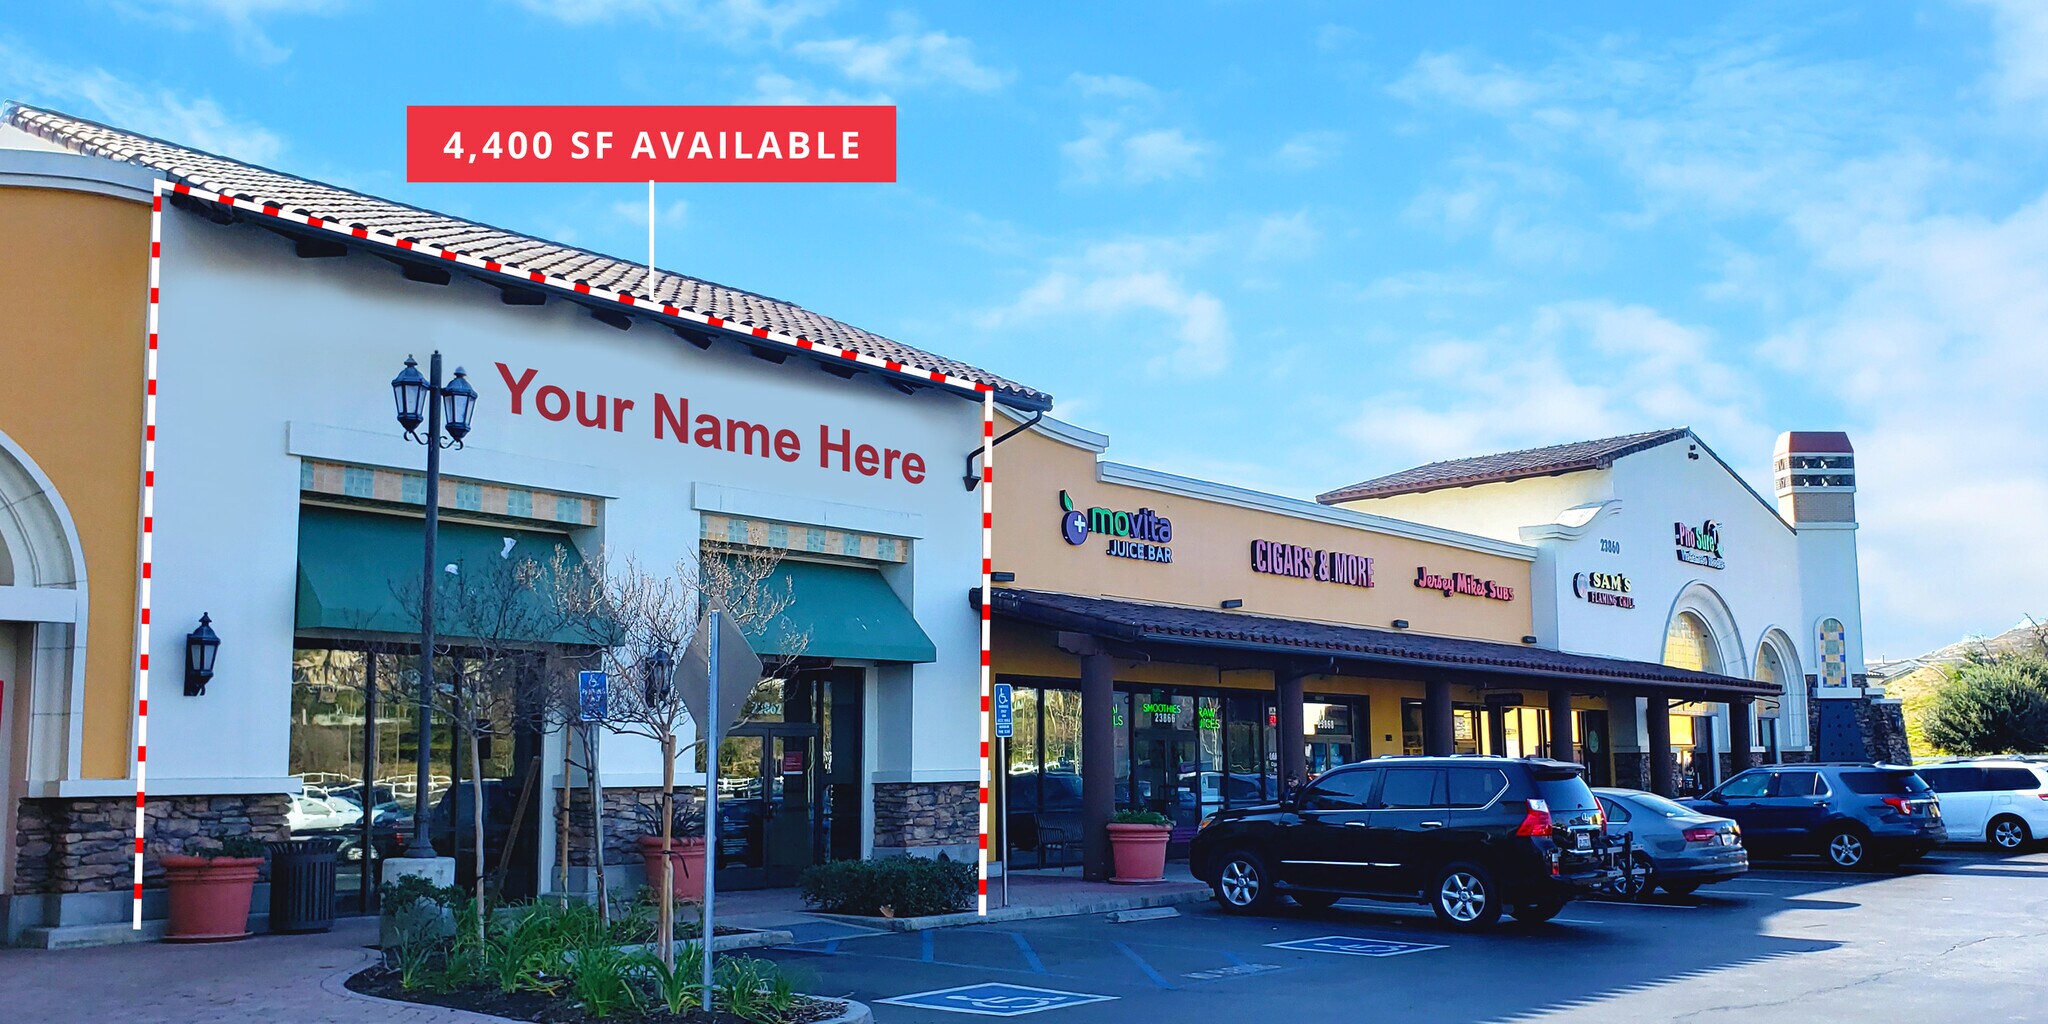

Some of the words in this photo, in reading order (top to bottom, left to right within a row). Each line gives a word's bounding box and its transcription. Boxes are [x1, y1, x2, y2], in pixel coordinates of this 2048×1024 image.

[1088, 507, 1172, 543] movita
[1108, 540, 1145, 560] JUICE
[1147, 544, 1172, 563] BAR
[1600, 538, 1620, 555] 23860
[1253, 539, 1313, 579] CIGARS
[1315, 550, 1330, 581] &
[1331, 552, 1375, 587] MORE
[1416, 566, 1454, 597] Jersey
[1143, 703, 1182, 714] SMOOTHIES
